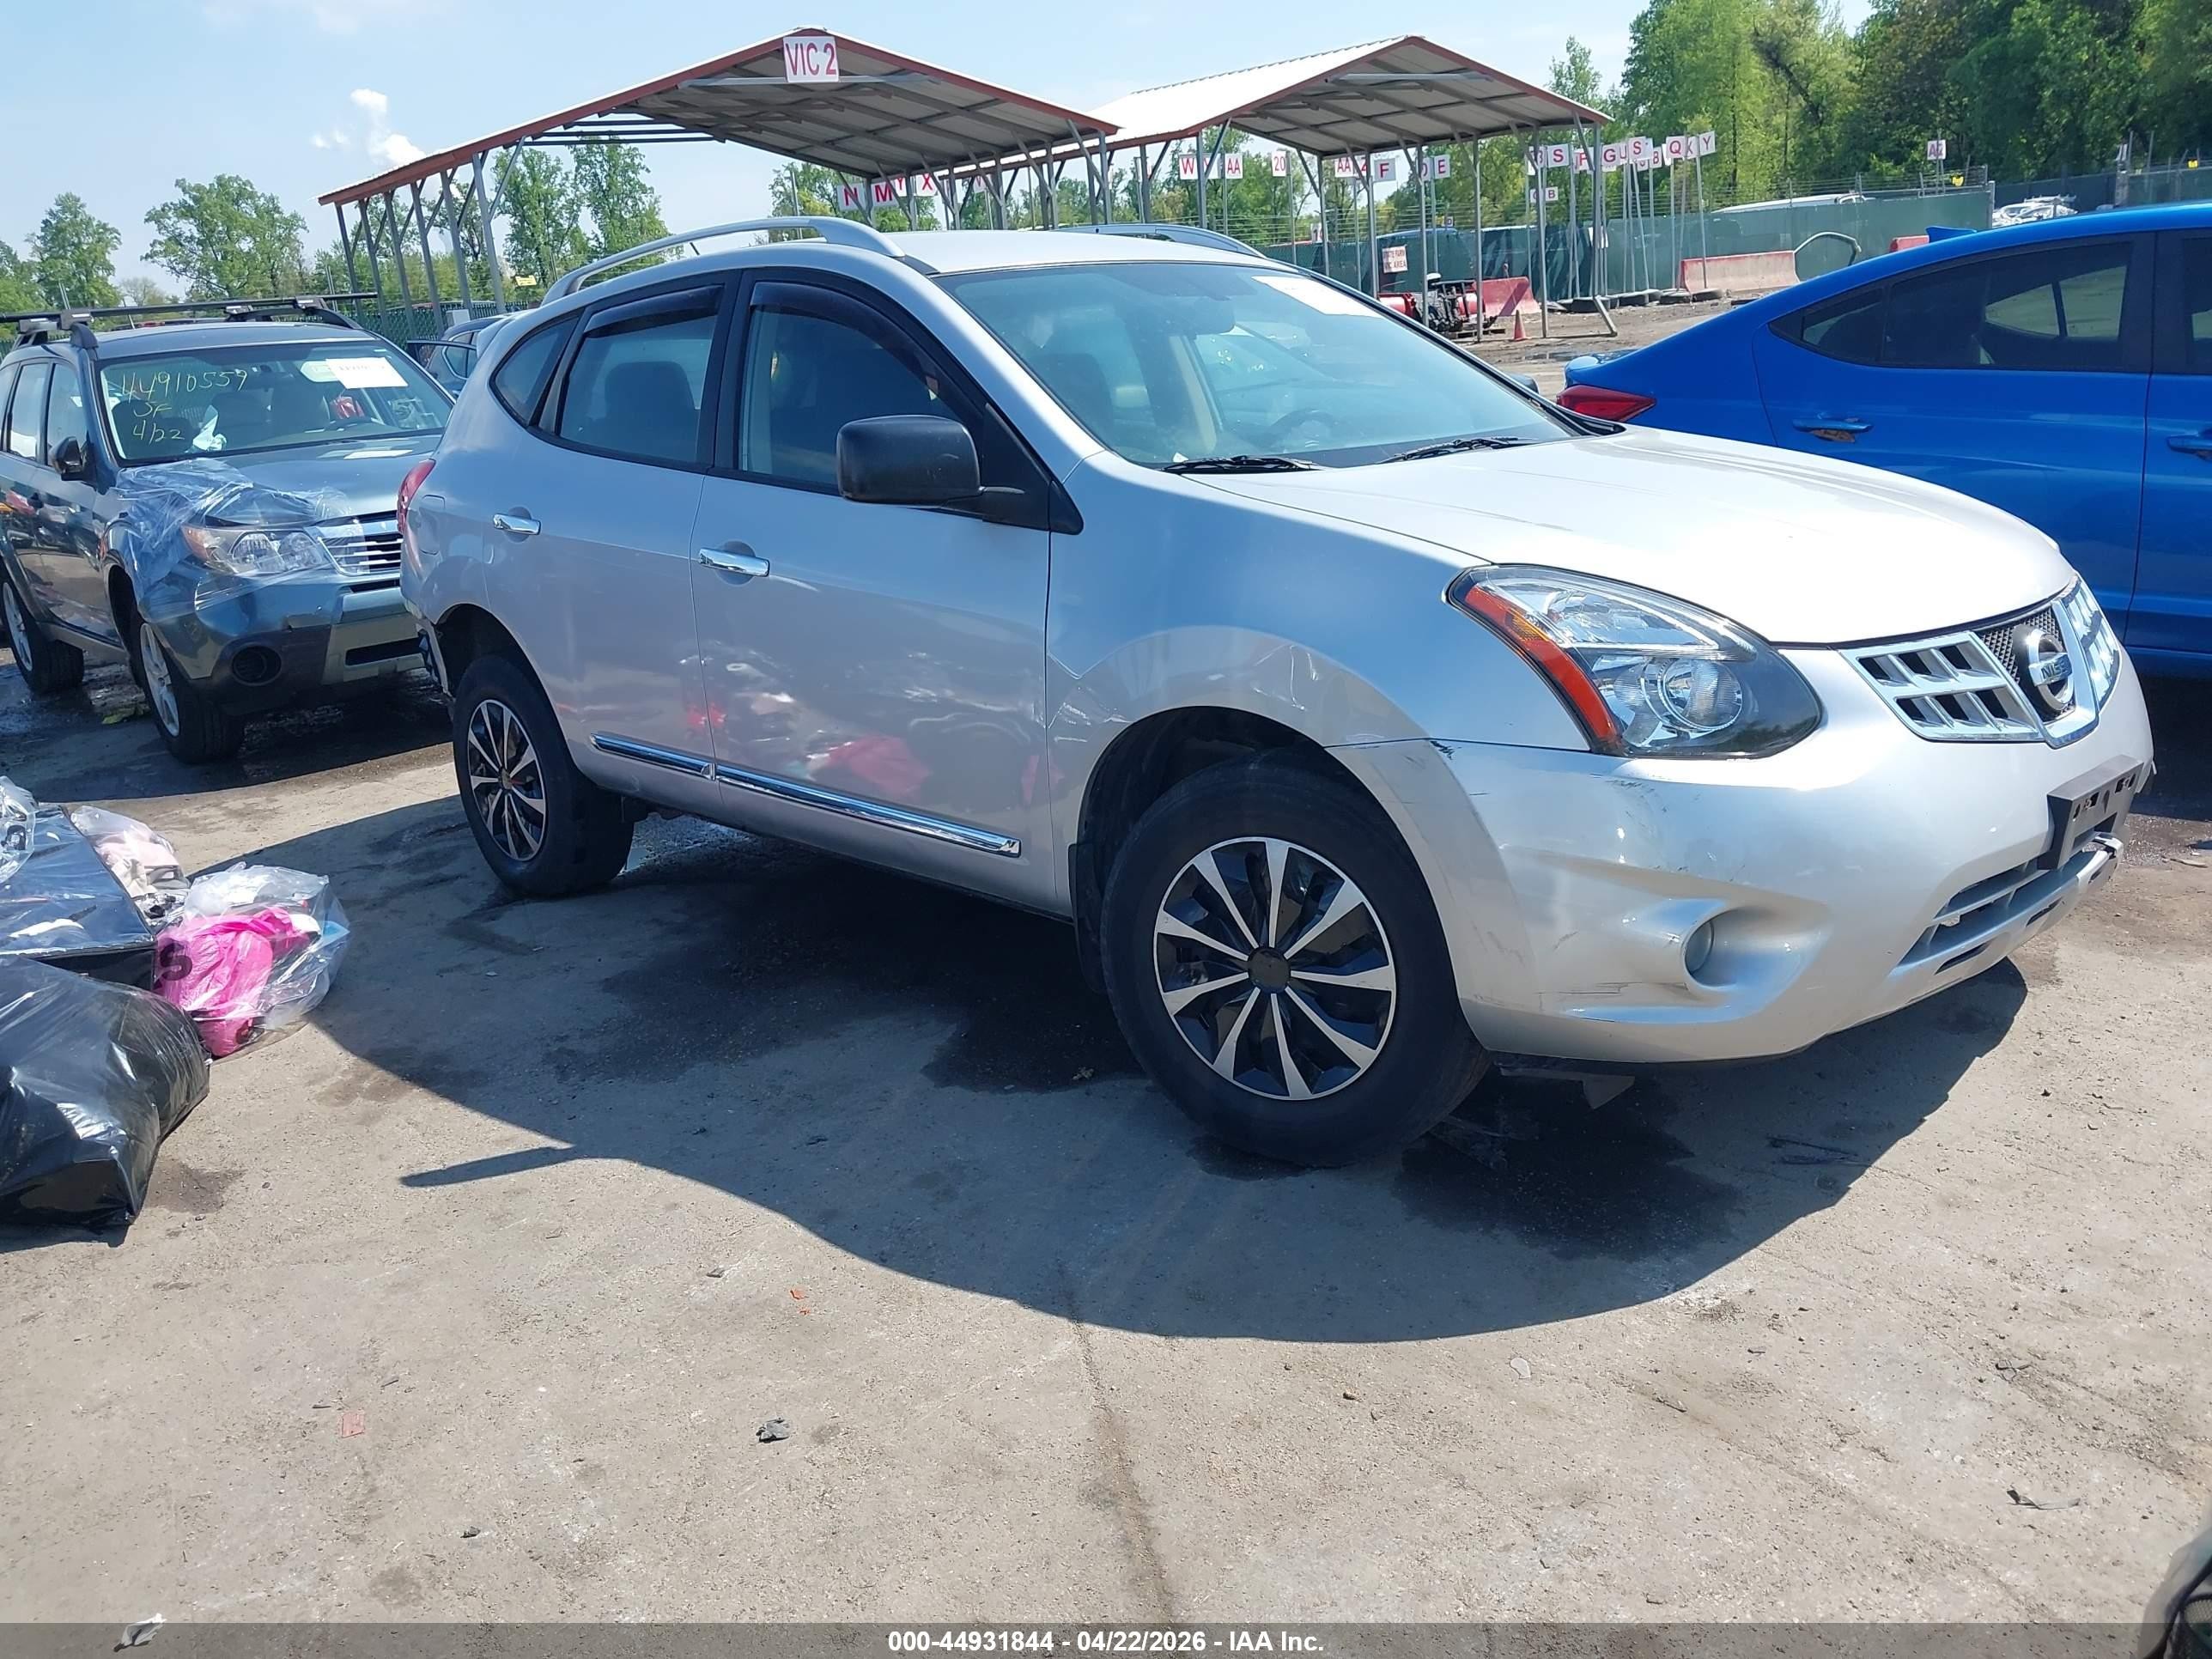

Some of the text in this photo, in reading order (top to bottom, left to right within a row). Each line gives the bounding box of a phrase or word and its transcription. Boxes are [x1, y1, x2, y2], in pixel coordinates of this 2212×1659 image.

[785, 42, 836, 76] VIC 2
[1633, 141, 1642, 155] S
[1669, 140, 1681, 155] Q
[1703, 136, 1711, 150] Y
[1553, 149, 1564, 163] S
[1603, 149, 1616, 162] G
[1182, 158, 1194, 174] W
[1227, 159, 1241, 173] AA
[1273, 156, 1286, 171] 20
[1336, 157, 1352, 172] AA
[1379, 163, 1389, 178] F
[1437, 159, 1446, 174] E
[921, 173, 933, 191] X
[843, 186, 859, 206] N
[875, 184, 892, 203] M
[1548, 189, 1555, 199] B
[122, 369, 248, 405] 44910559
